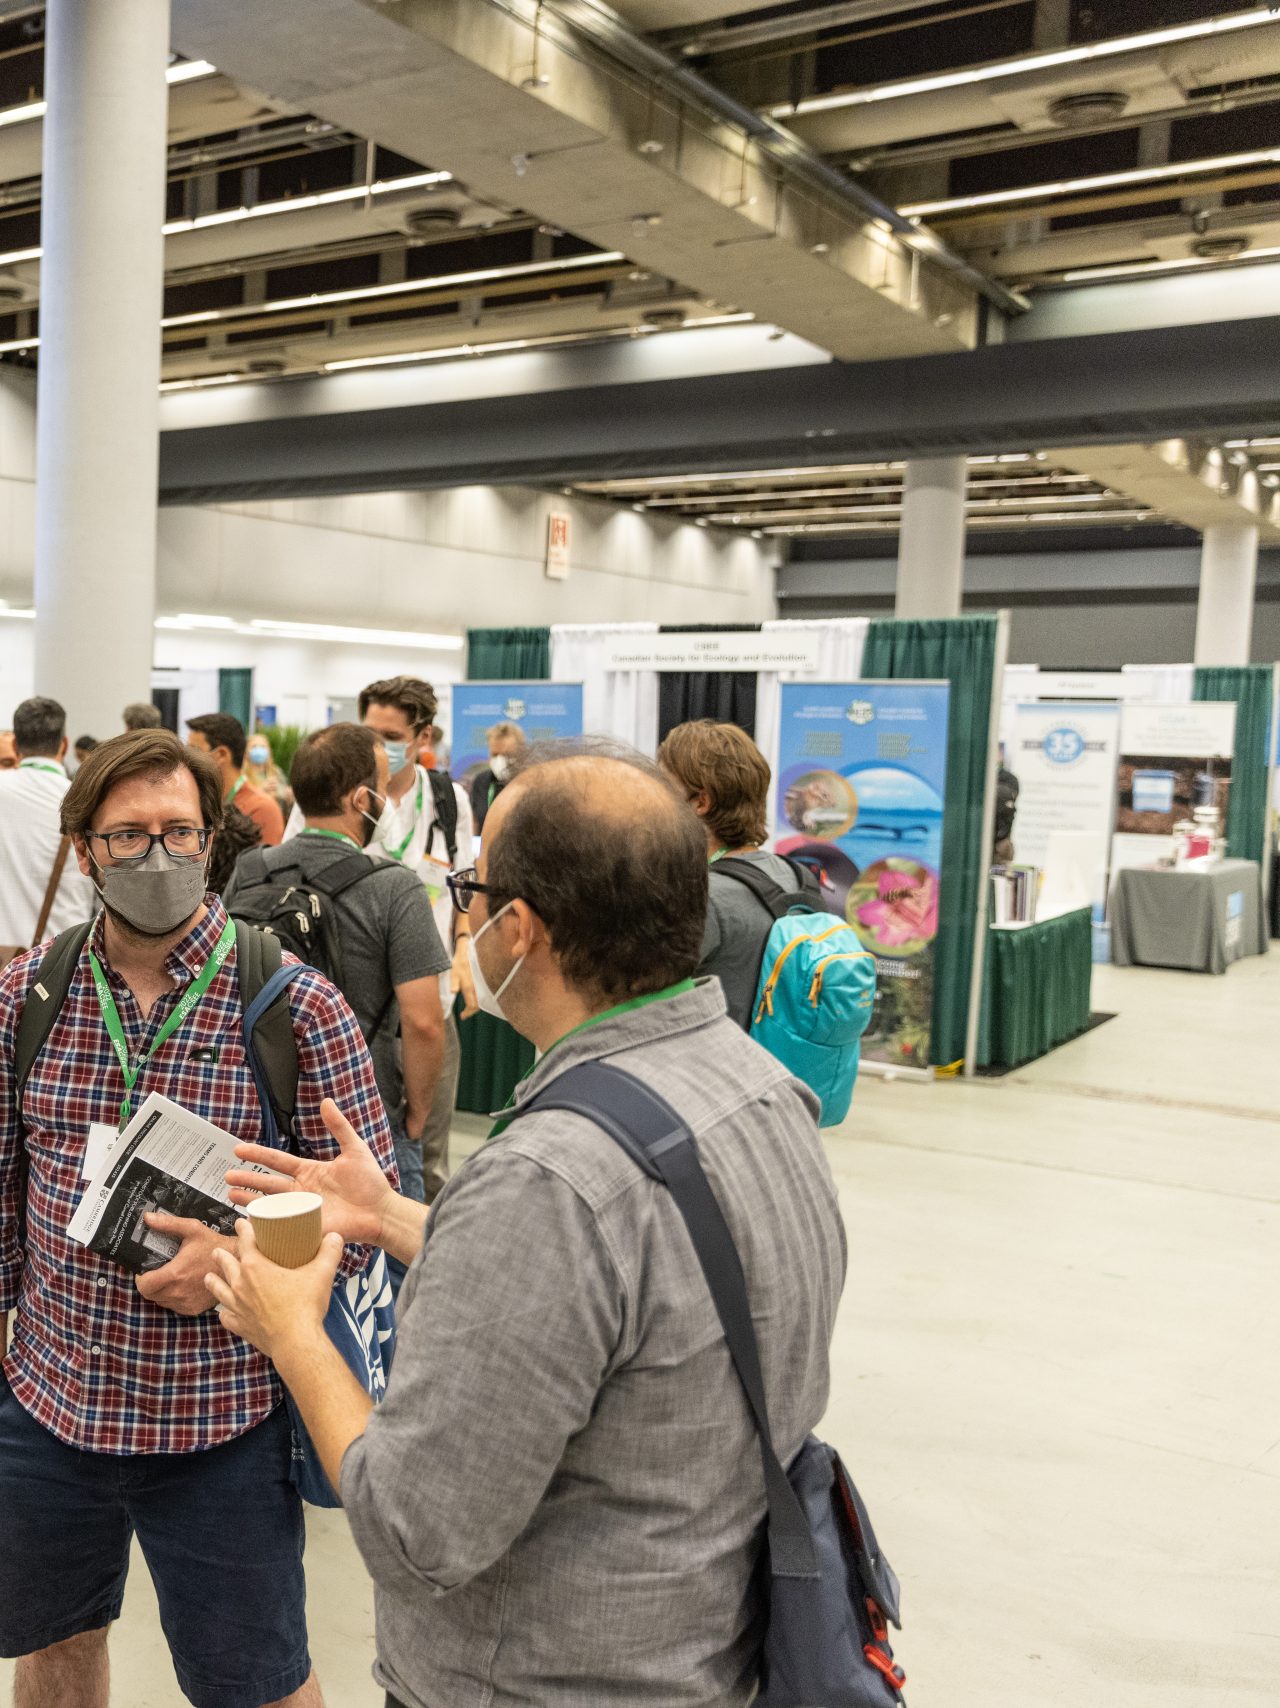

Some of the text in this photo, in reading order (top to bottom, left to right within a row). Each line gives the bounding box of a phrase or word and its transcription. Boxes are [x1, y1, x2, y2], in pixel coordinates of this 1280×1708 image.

[611, 654, 651, 663] Canadian
[654, 654, 685, 664] Society
[703, 653, 738, 664] Ecology
[743, 653, 759, 663] and
[762, 653, 808, 663] Evolution
[1050, 732, 1078, 753] 35
[213, 940, 226, 956] 2022
[101, 984, 112, 1001] 2022
[177, 993, 191, 1010] 2022
[144, 1114, 157, 1128] ONLINE
[131, 1126, 148, 1146] DISCOUNT
[202, 1141, 216, 1156] TERMS
[196, 1154, 207, 1165] AND
[133, 1174, 152, 1202] COMSTOCK
[83, 1198, 105, 1233] CAMBRIDGE
[119, 1202, 130, 1217] Cornell
[121, 1199, 138, 1229] PUBLISHING
[111, 1215, 123, 1234] University
[108, 1226, 126, 1256] ASSOCIATES
